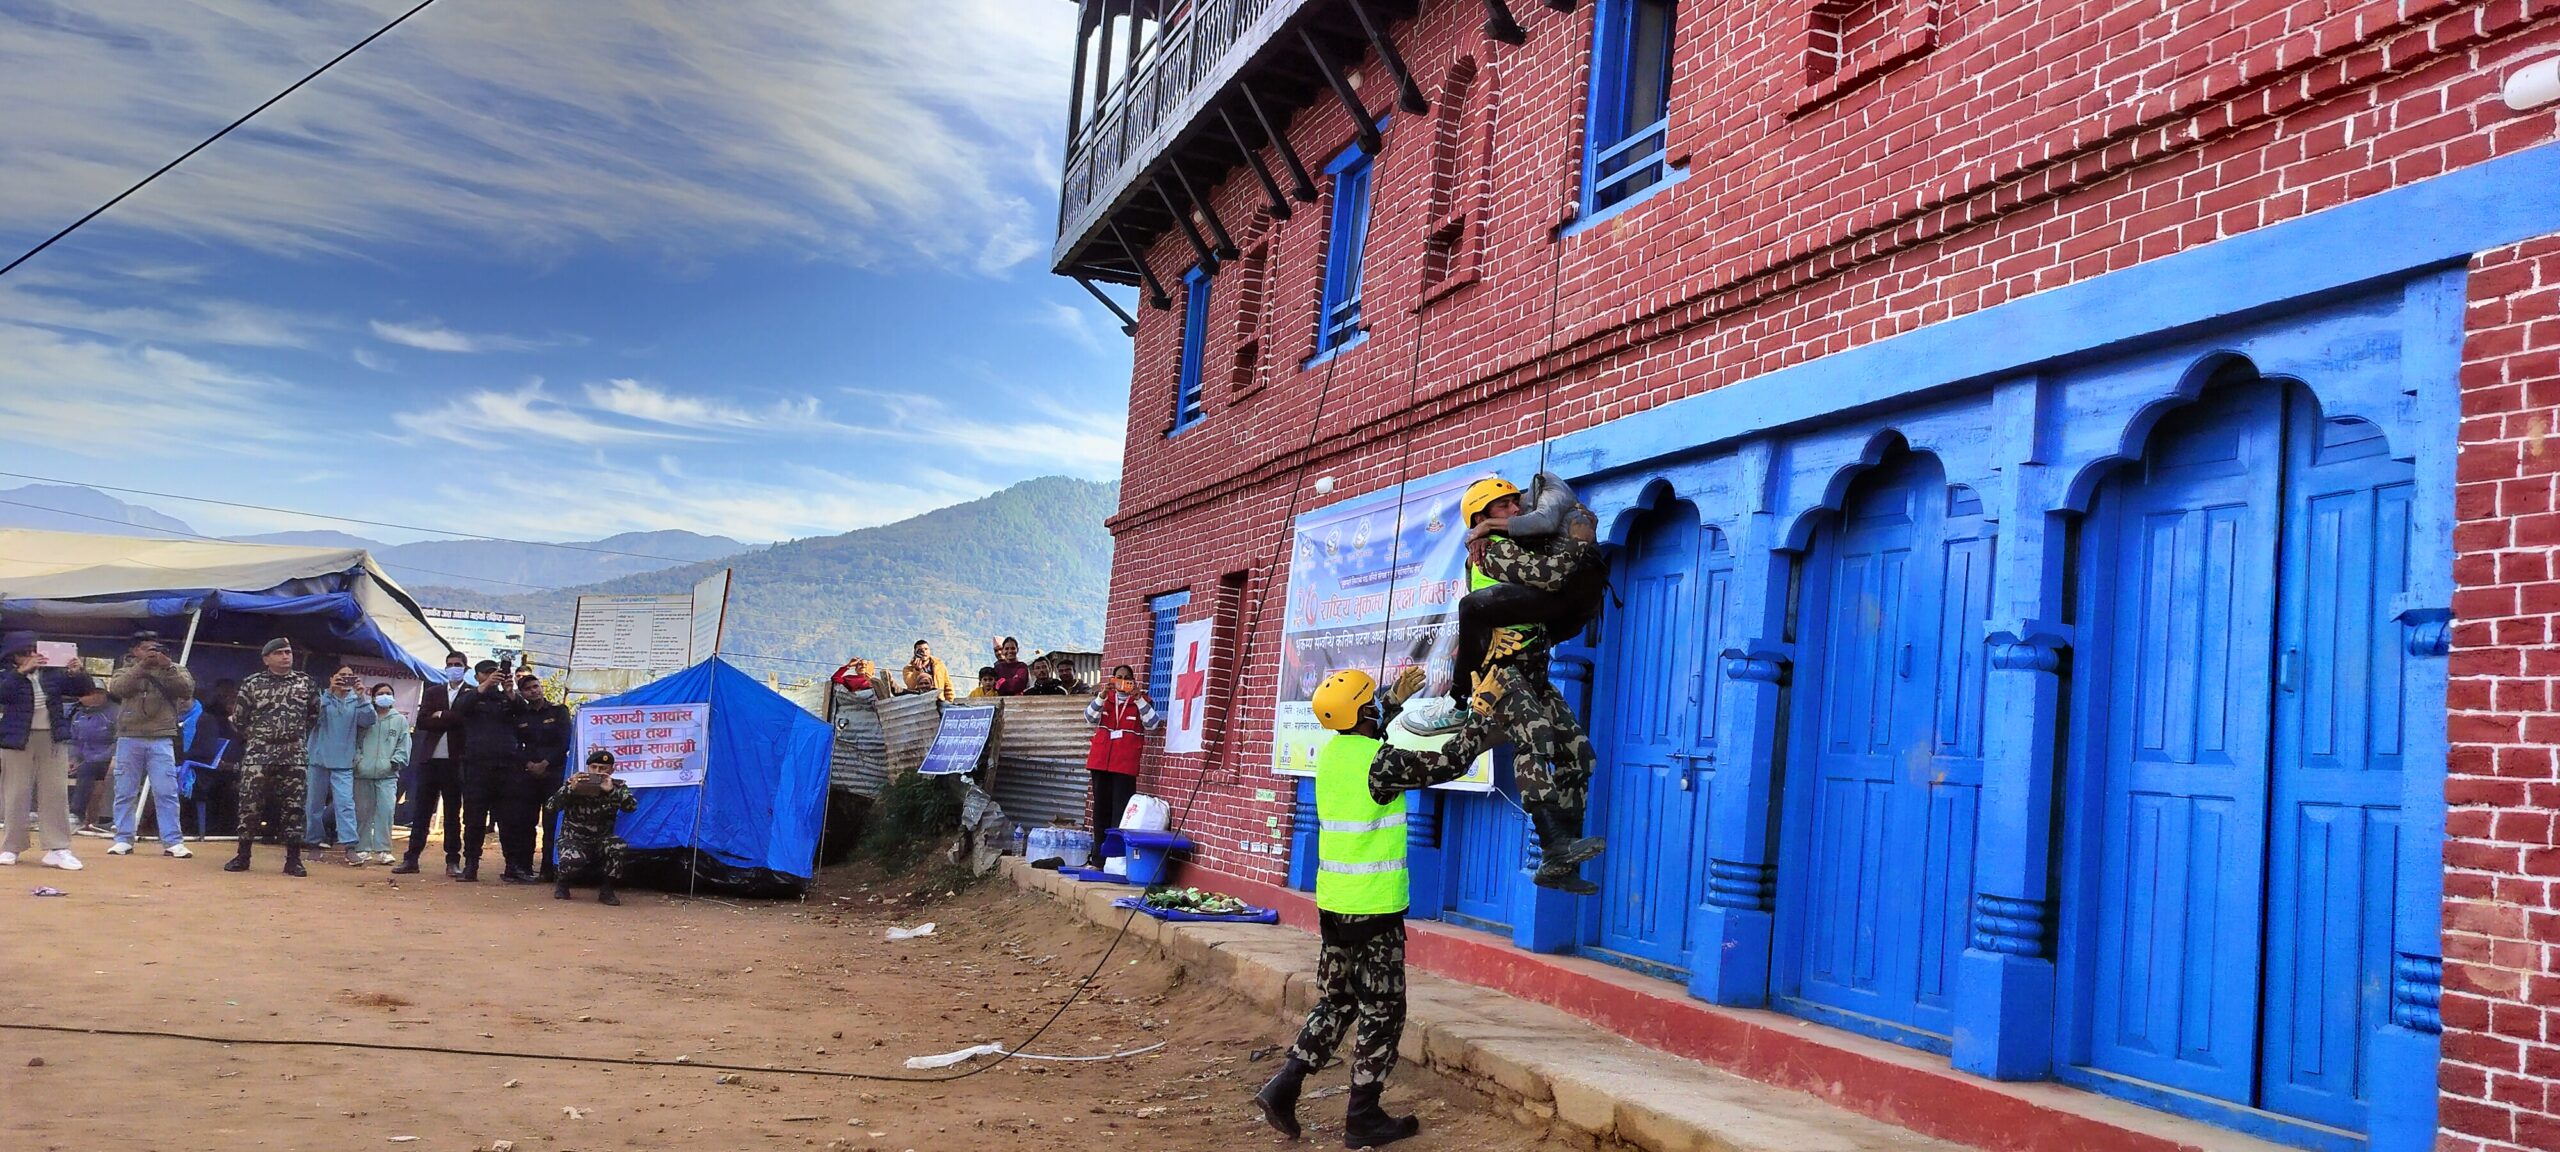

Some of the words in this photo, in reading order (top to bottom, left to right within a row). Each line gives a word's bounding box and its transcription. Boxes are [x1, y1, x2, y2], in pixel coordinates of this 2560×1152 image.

[590, 710, 645, 725] अस्थायी
[649, 710, 693, 722] आवास
[646, 728, 672, 739] तथा
[651, 756, 684, 770] केन्द्र
